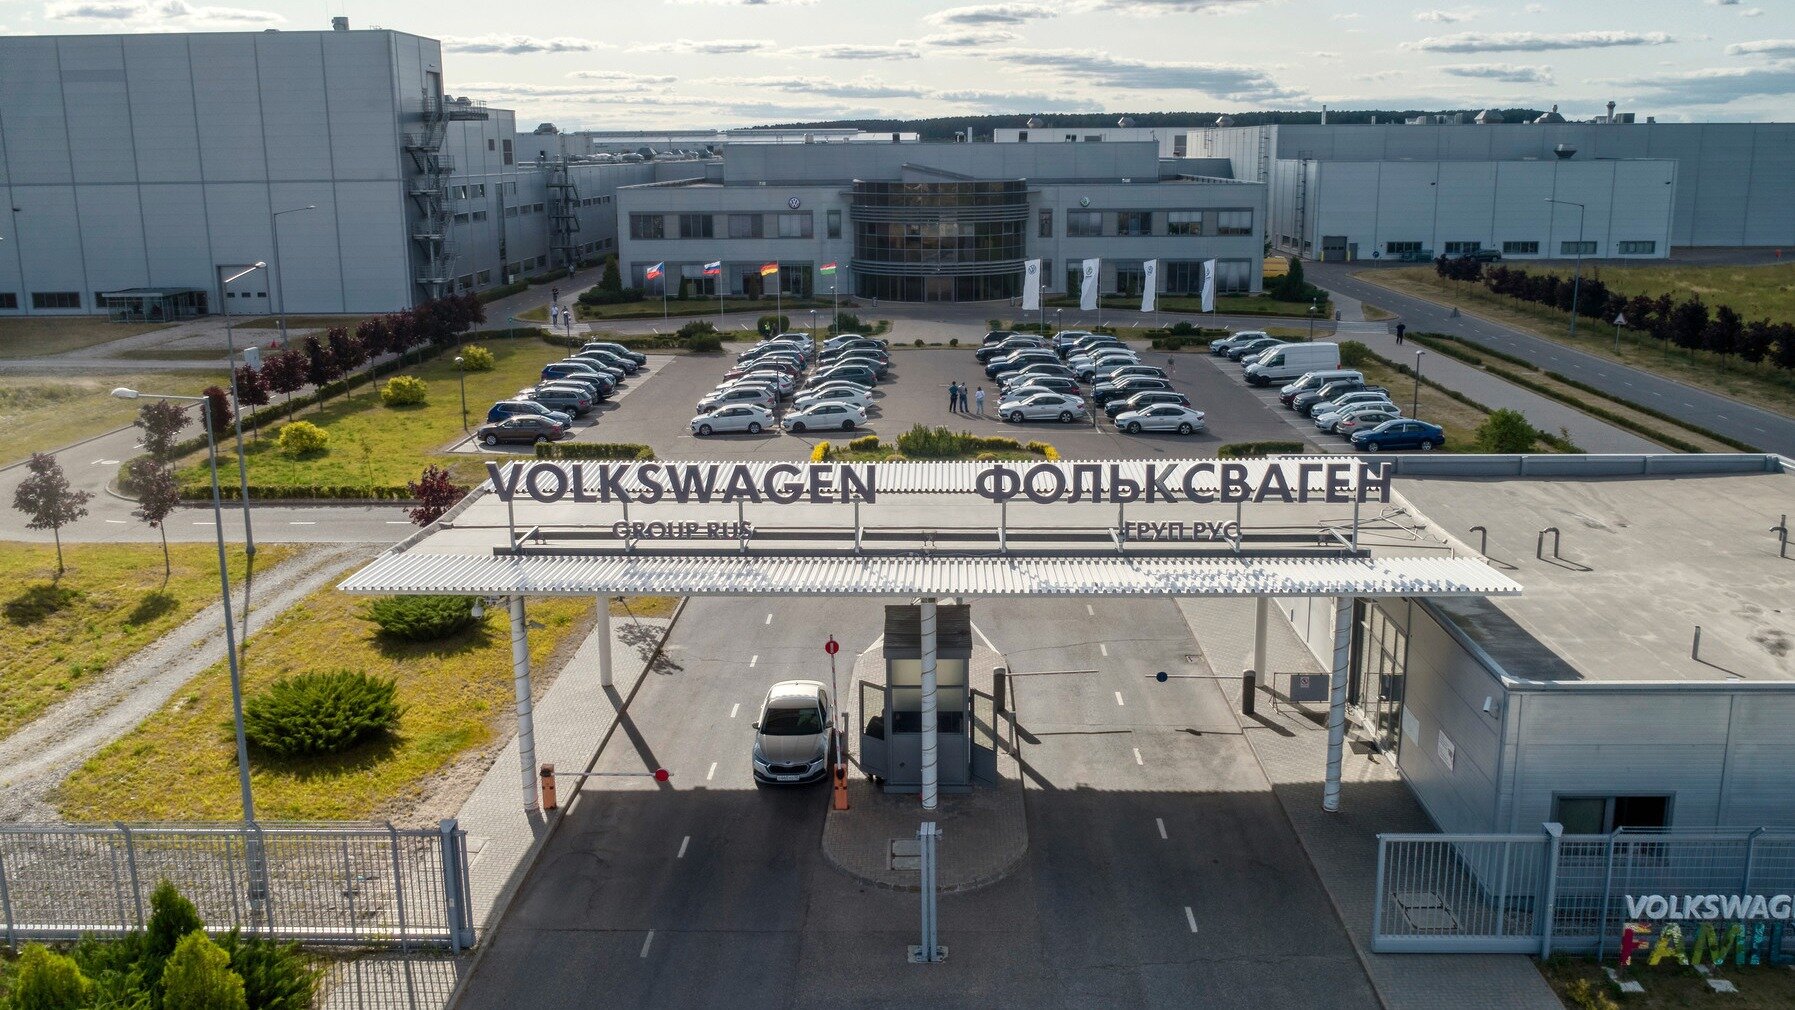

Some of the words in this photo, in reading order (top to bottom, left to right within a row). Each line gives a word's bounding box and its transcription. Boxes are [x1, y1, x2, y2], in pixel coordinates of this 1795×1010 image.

[485, 461, 877, 503] VOLKSWAGEN
[975, 463, 1392, 503] ФОЛЬКСВАГЕН
[613, 520, 698, 540] GROUP
[706, 520, 752, 540] RUS
[1124, 521, 1184, 540] ГРУП
[1192, 521, 1239, 540] РУС
[1625, 894, 1795, 919] VOLKSWAG
[1619, 922, 1795, 965] FAMIL
